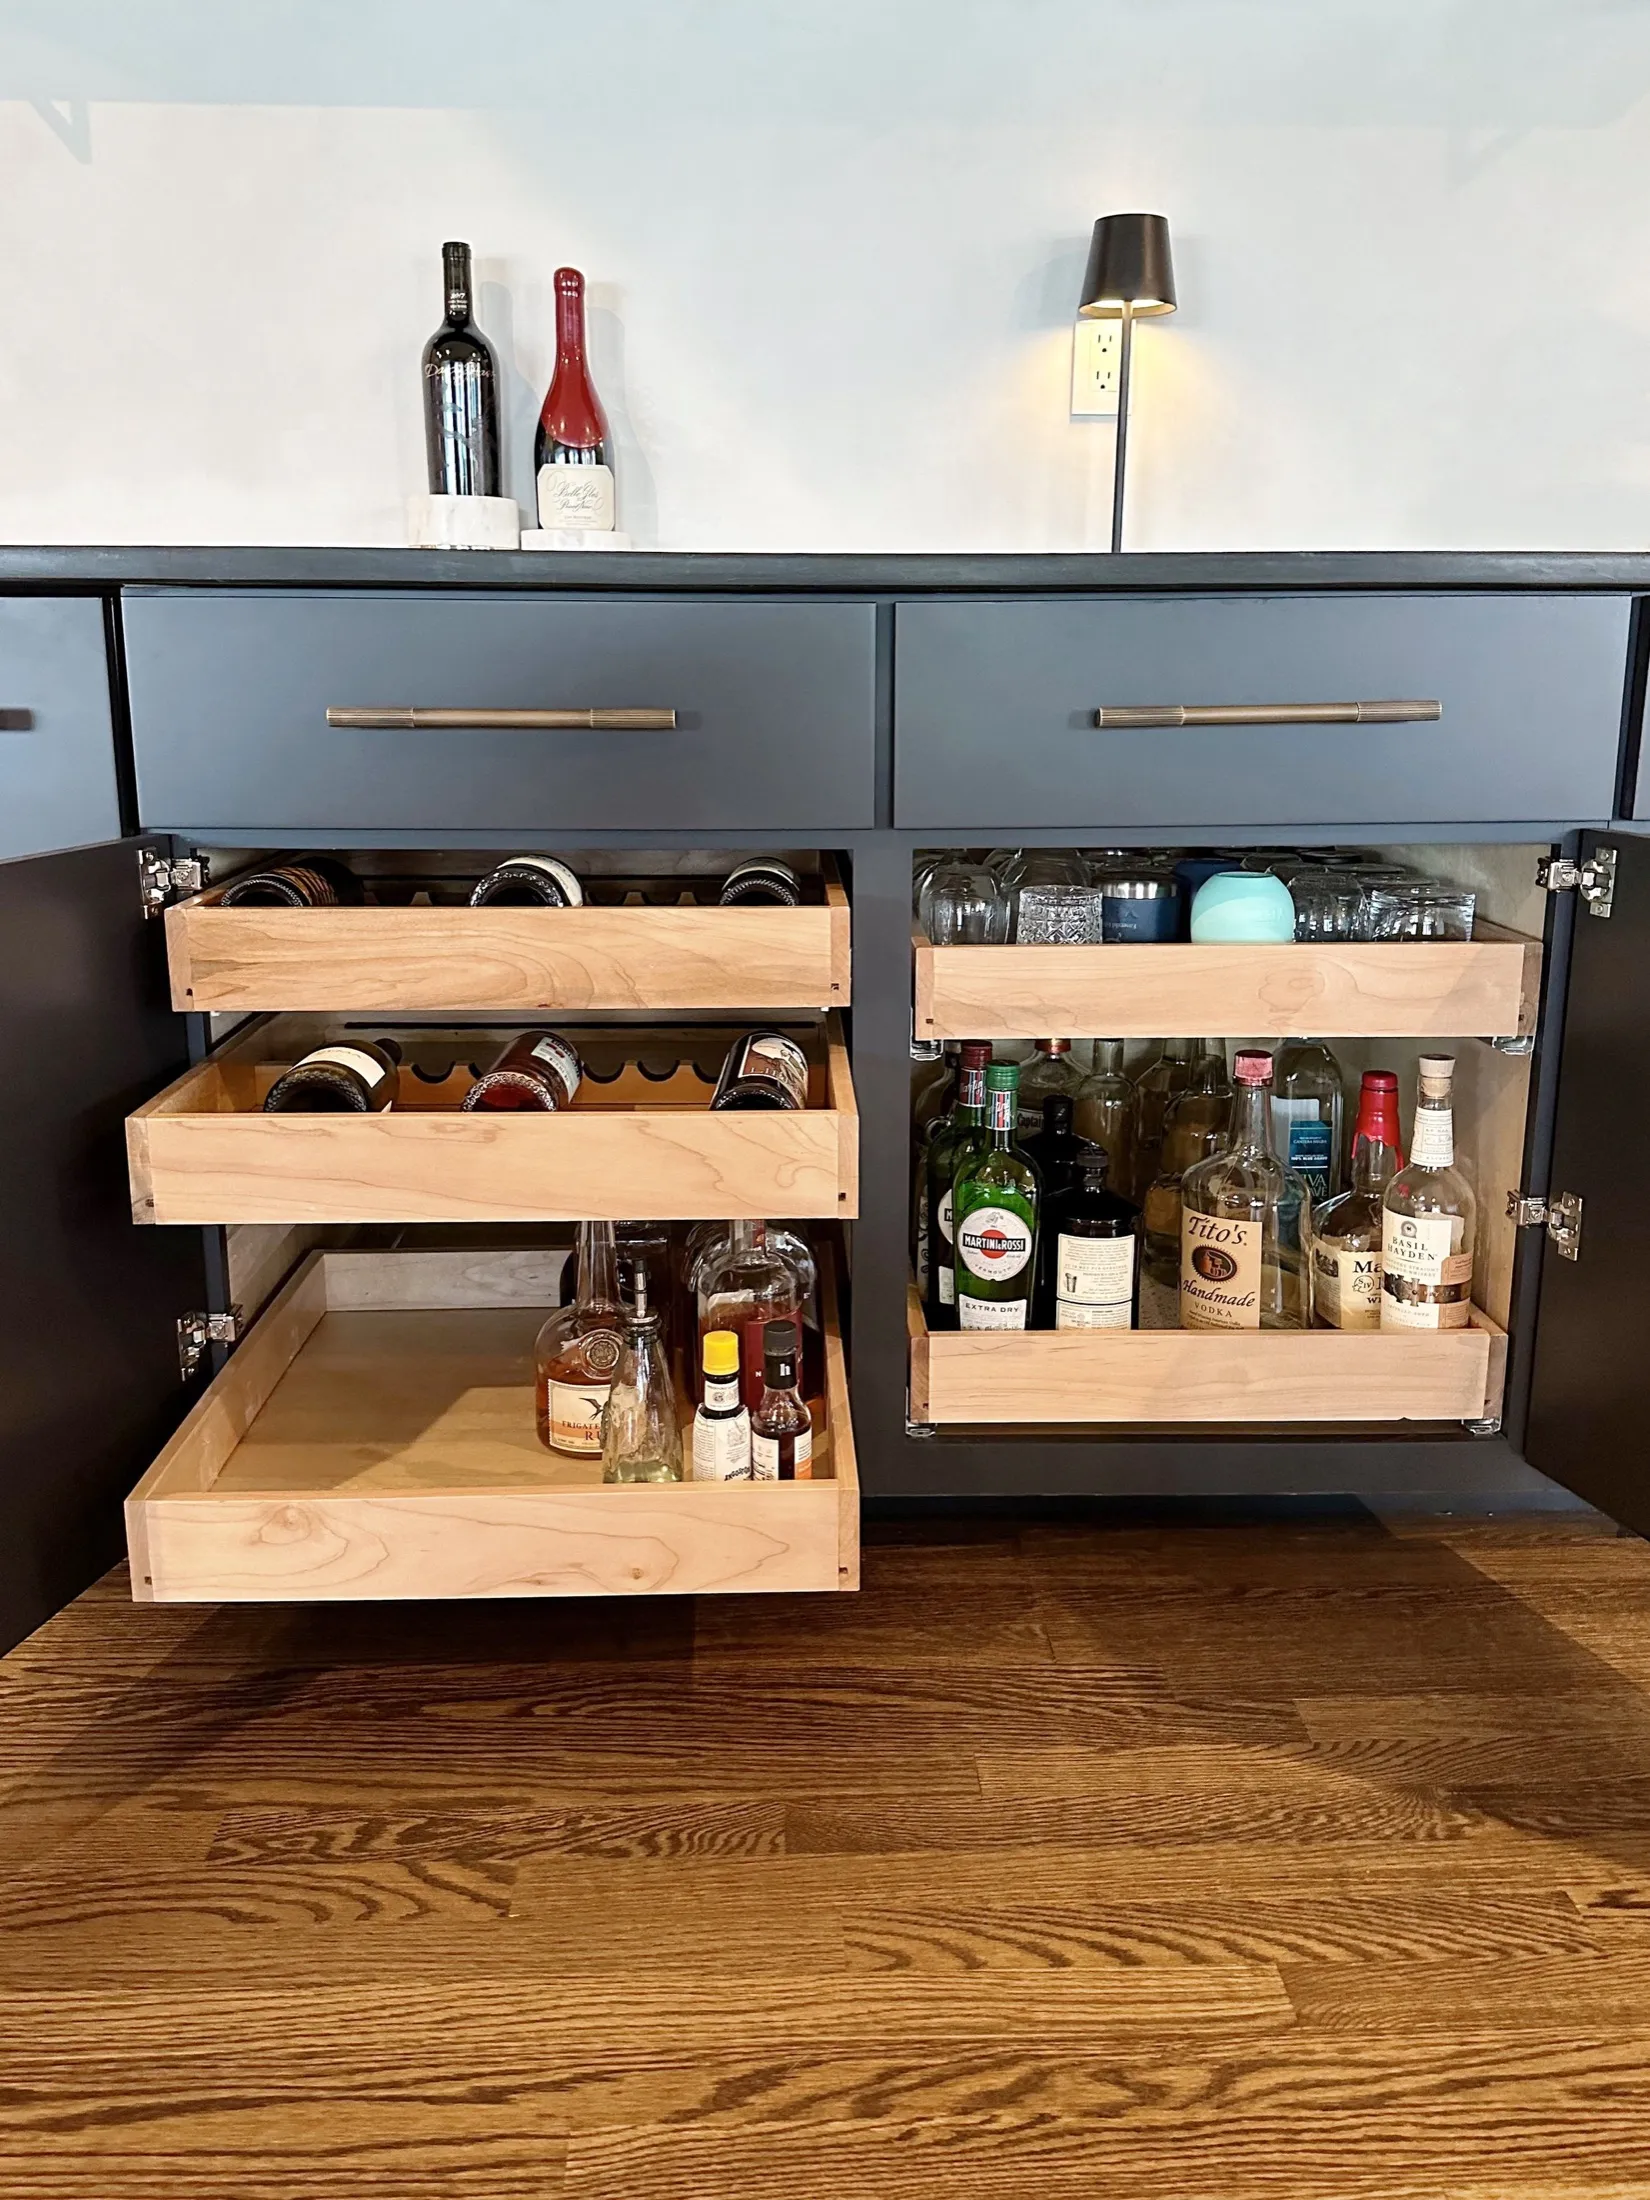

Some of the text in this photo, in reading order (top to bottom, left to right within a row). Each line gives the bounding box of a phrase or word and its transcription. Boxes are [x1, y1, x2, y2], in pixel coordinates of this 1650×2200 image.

[1392, 1236, 1429, 1251] BASIL
[1387, 1243, 1435, 1261] HAYDEN
[1182, 1279, 1256, 1307] Handmade
[965, 1302, 997, 1313] EXTRA
[1194, 1301, 1233, 1318] VODKA
[779, 1363, 791, 1377] h
[561, 1420, 601, 1430] FRIGATE
